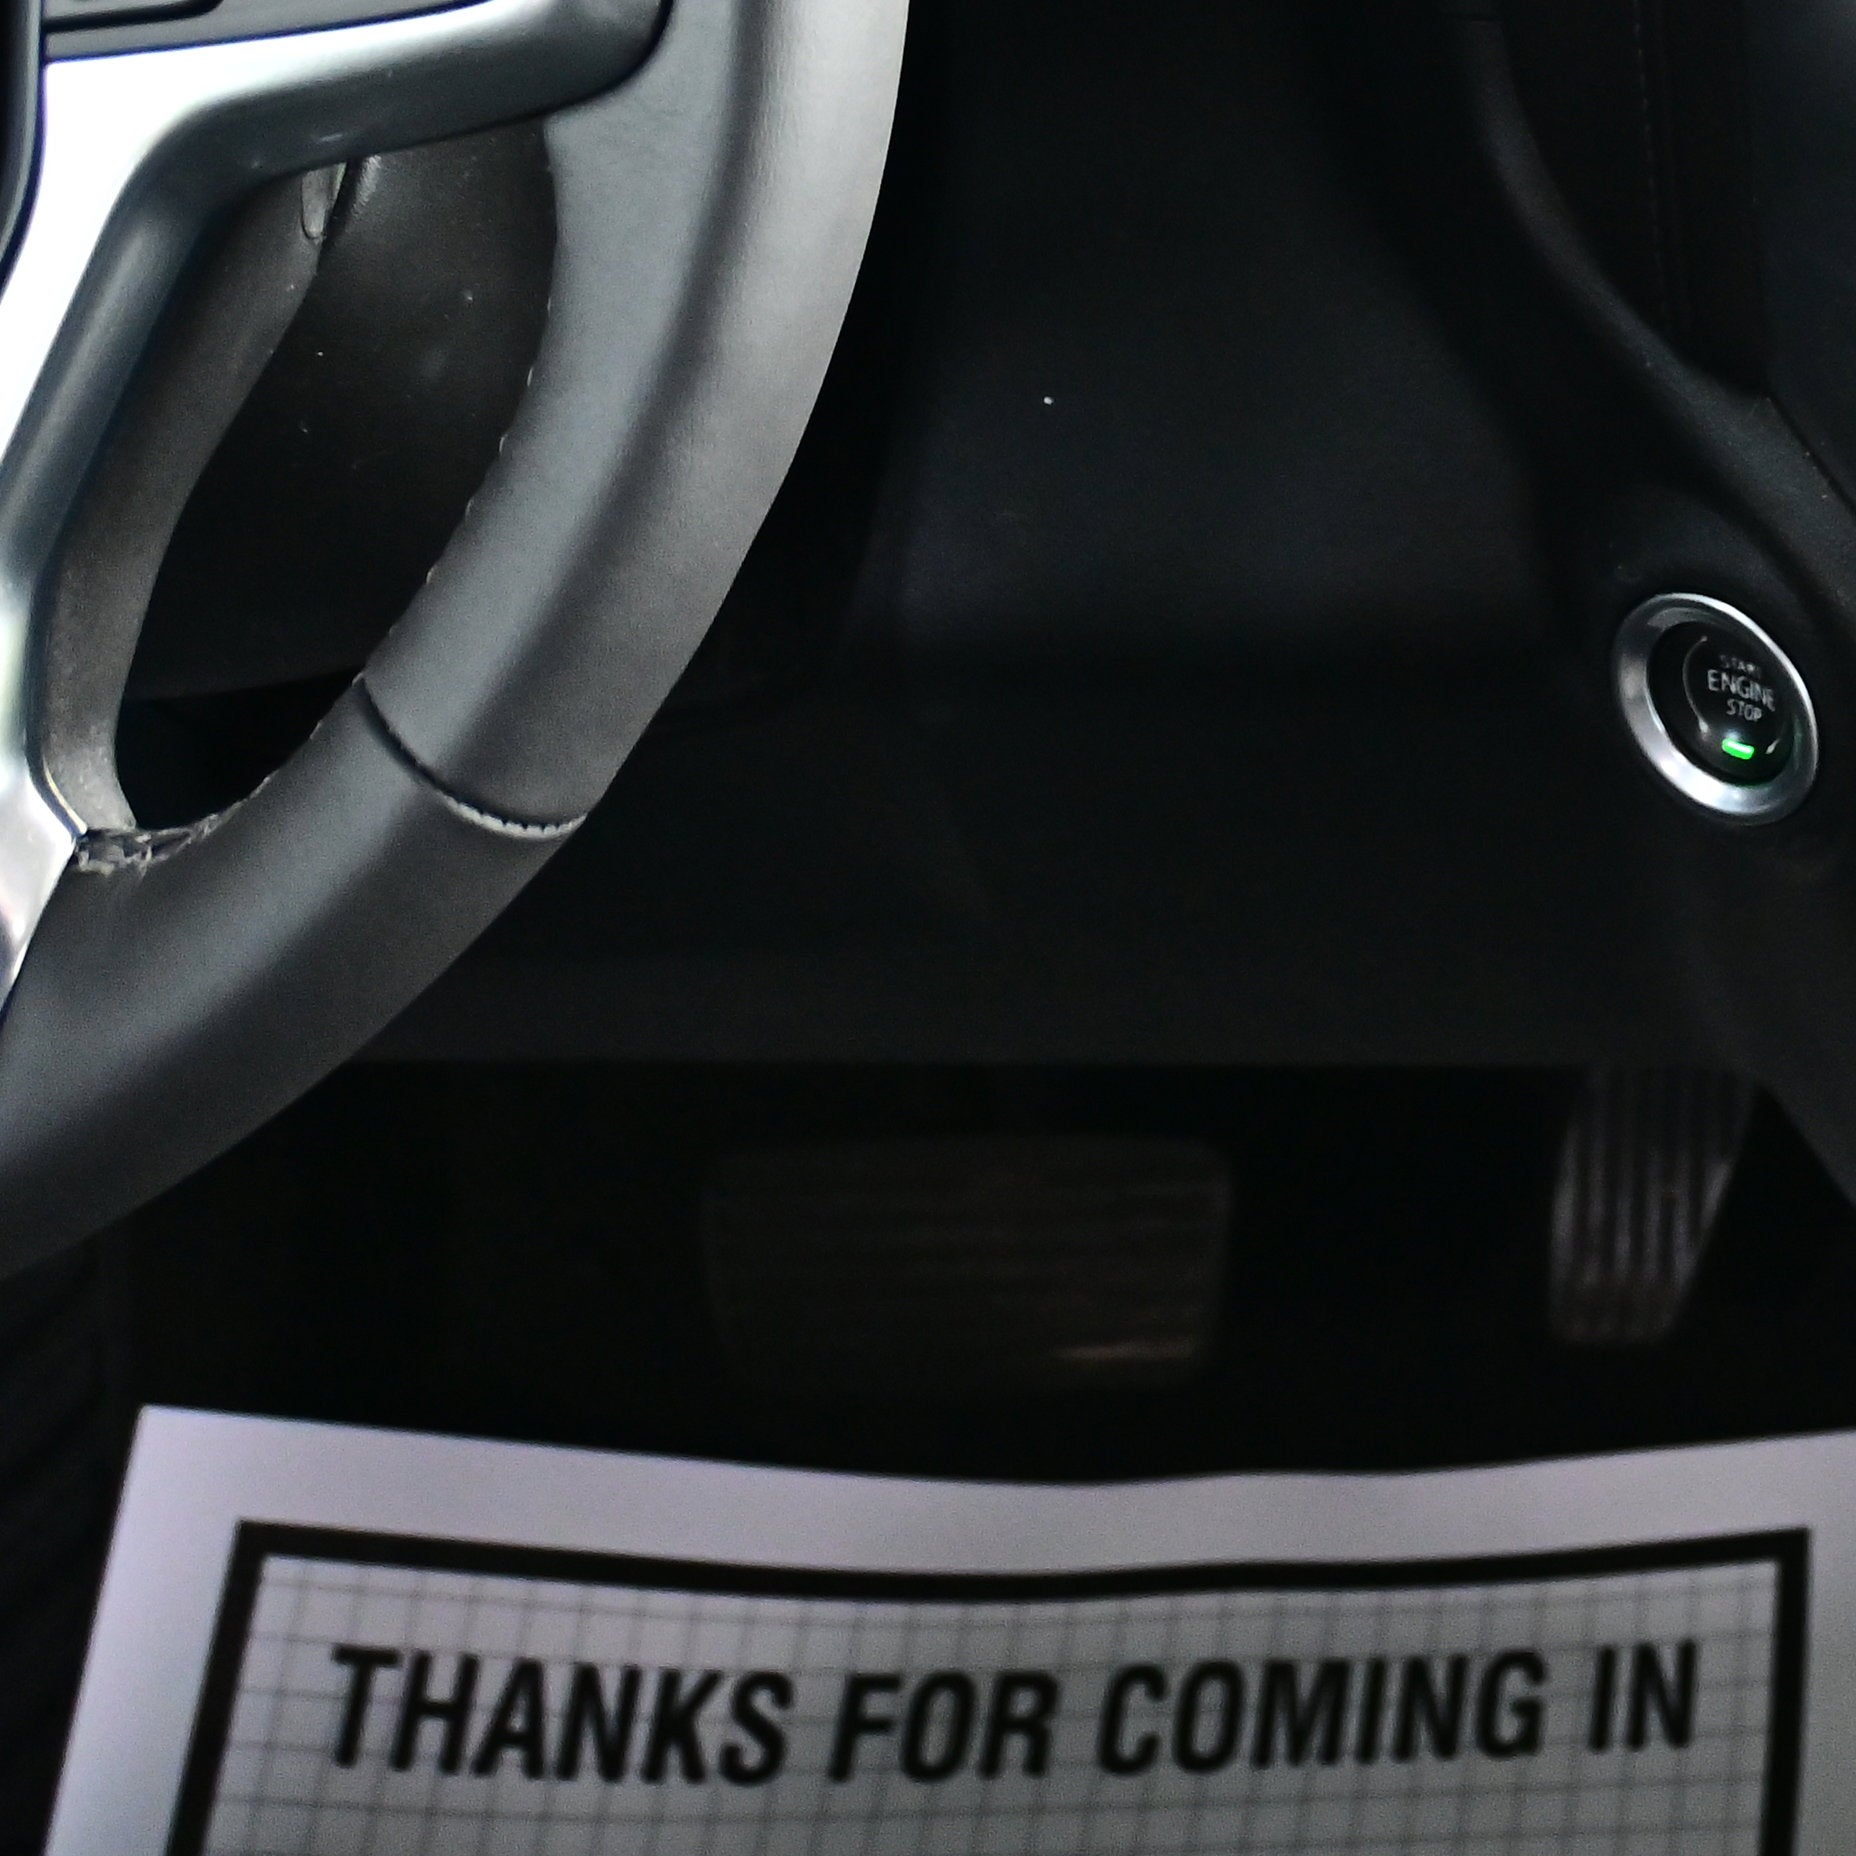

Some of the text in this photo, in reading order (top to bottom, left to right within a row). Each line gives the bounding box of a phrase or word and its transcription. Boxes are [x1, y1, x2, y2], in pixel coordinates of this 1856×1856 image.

[1707, 668, 1775, 712] ENGINE
[1726, 698, 1763, 722] STOP
[328, 1638, 1698, 1787] THANKS FOR COMING IN
